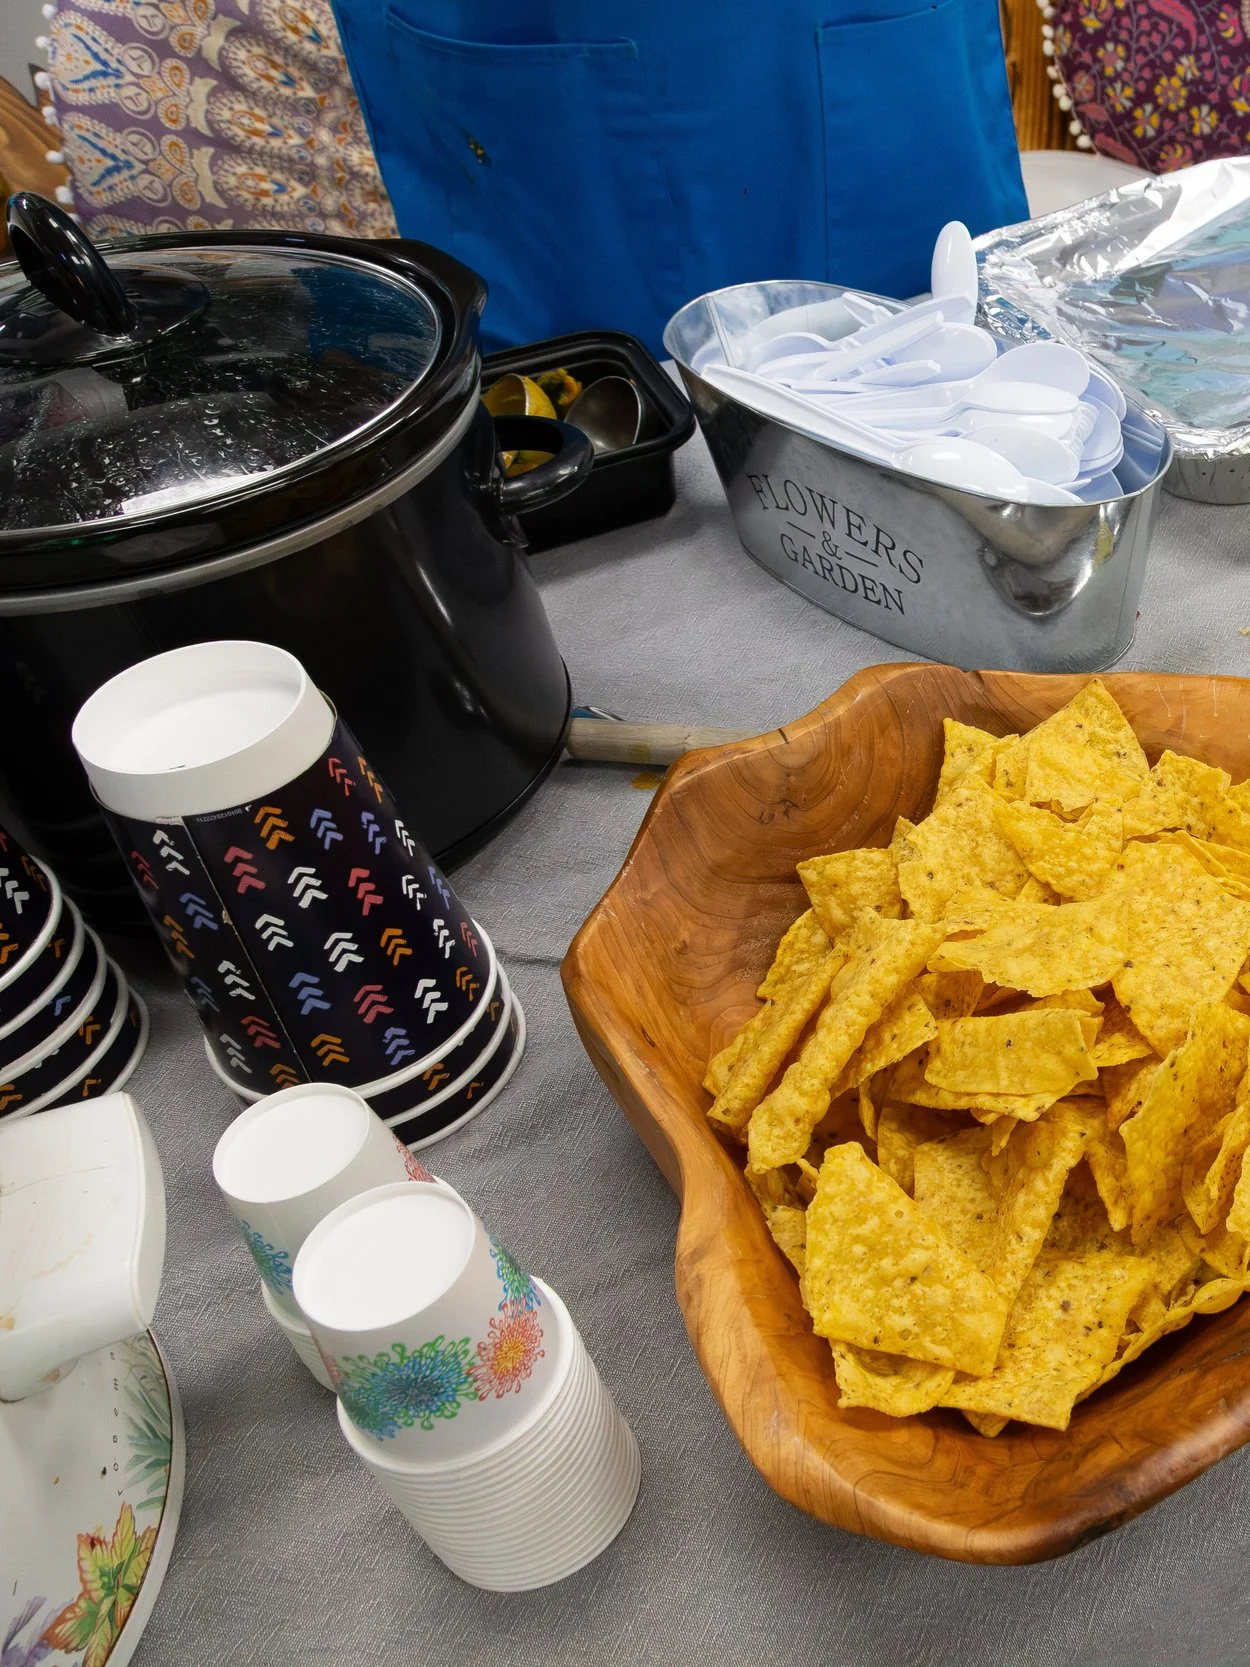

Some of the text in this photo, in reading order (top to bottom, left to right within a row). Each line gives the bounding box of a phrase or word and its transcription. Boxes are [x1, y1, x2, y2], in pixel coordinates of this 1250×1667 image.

[747, 474, 924, 584] FLOWERS
[821, 530, 842, 560] &
[780, 533, 905, 615] GARDEN
